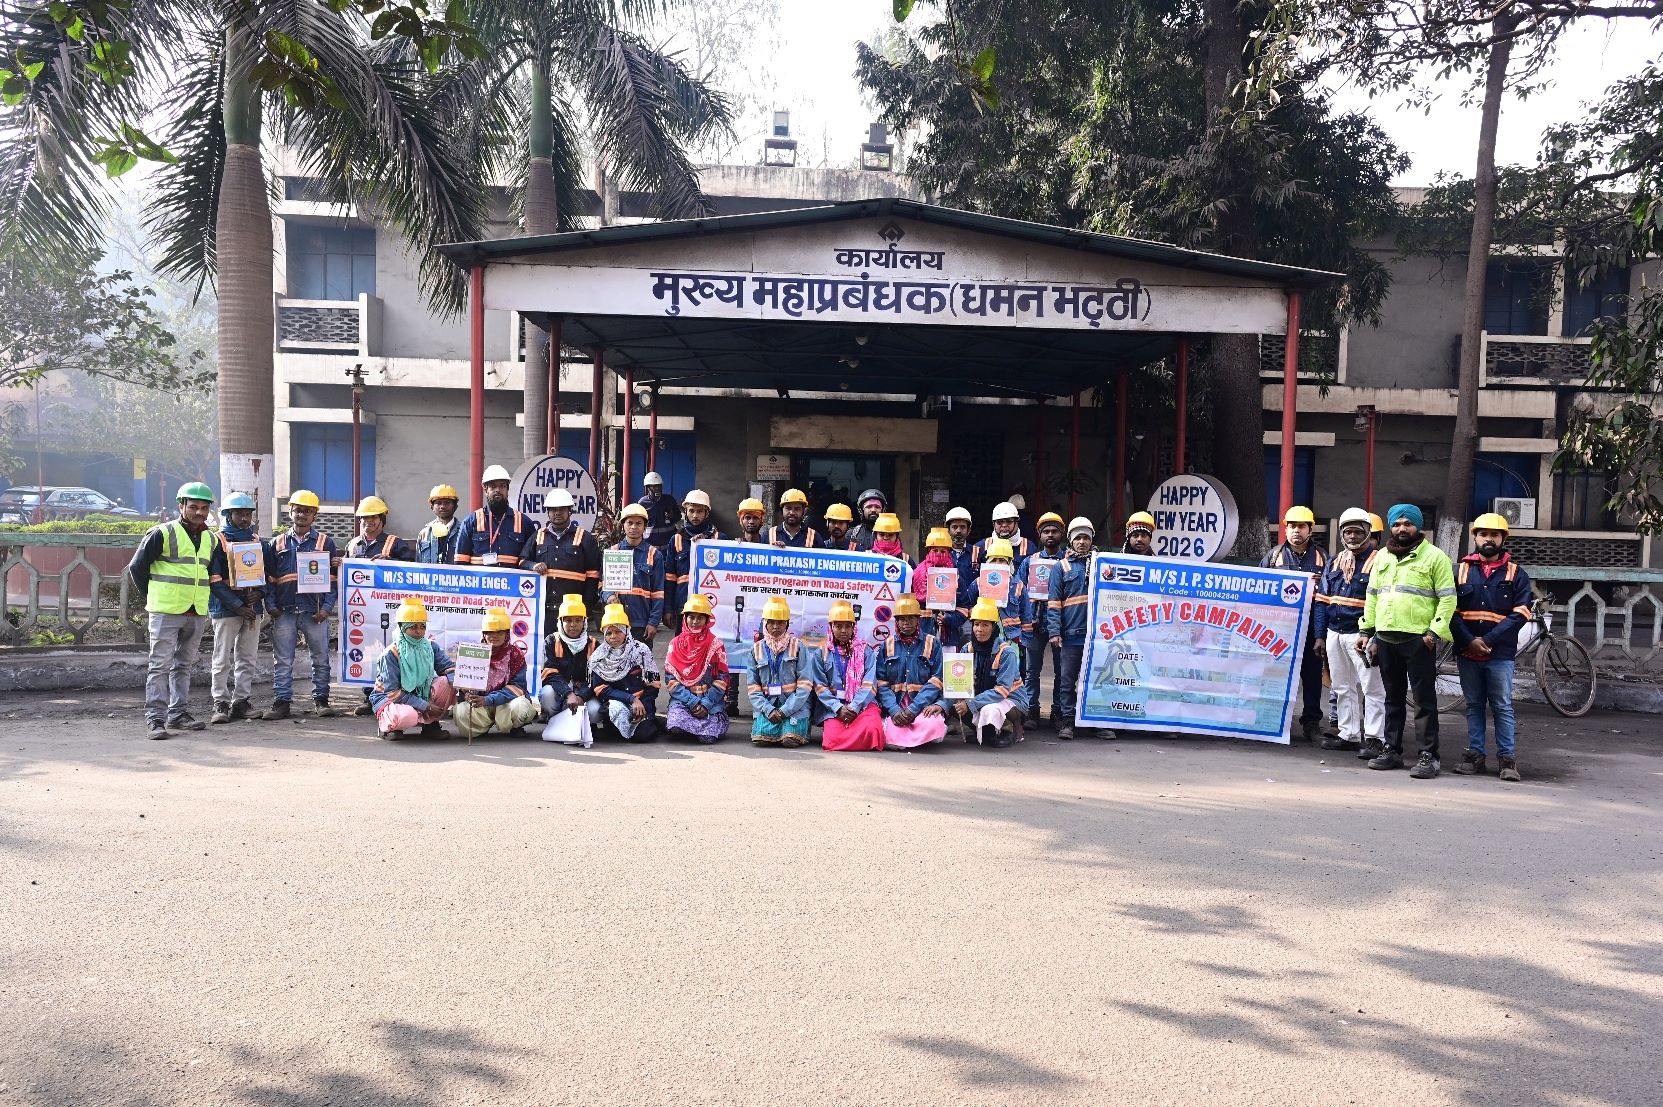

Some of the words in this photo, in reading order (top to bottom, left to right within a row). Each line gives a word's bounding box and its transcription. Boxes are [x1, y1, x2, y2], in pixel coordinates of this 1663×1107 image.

[833, 242, 946, 271] कार्यालय
[649, 271, 747, 316] मुख्य
[535, 466, 585, 489] HAPPY
[571, 495, 596, 515] EAR
[1159, 485, 1210, 506] HAPPY
[1178, 511, 1219, 533] YEAR
[1157, 536, 1206, 557] 2026
[723, 552, 744, 565] M/S
[770, 555, 816, 569] PRAKASH
[817, 558, 880, 574] ENGINEERING
[383, 570, 404, 584] M/S
[431, 573, 479, 588] PRAKASH
[481, 576, 511, 590] ENGG.
[724, 572, 771, 584] Awareness
[772, 576, 809, 588] Program
[811, 580, 821, 588] on
[823, 580, 845, 591] Road
[846, 582, 875, 594] Safety
[1148, 568, 1178, 586] M/S
[1180, 571, 1190, 587] J.
[1191, 572, 1202, 588] P.
[1205, 574, 1279, 596] SYNDICATE
[451, 596, 461, 604] on
[463, 596, 483, 606] Road
[485, 598, 511, 610] Safety
[1168, 587, 1189, 596] Code
[1195, 589, 1240, 601] 1000042840
[1099, 601, 1174, 641] SAFETY
[1178, 601, 1292, 659] CAMPAIGN
[1117, 652, 1139, 661] DATE
[1114, 678, 1136, 687] TIME
[1111, 702, 1140, 711] VENUE
